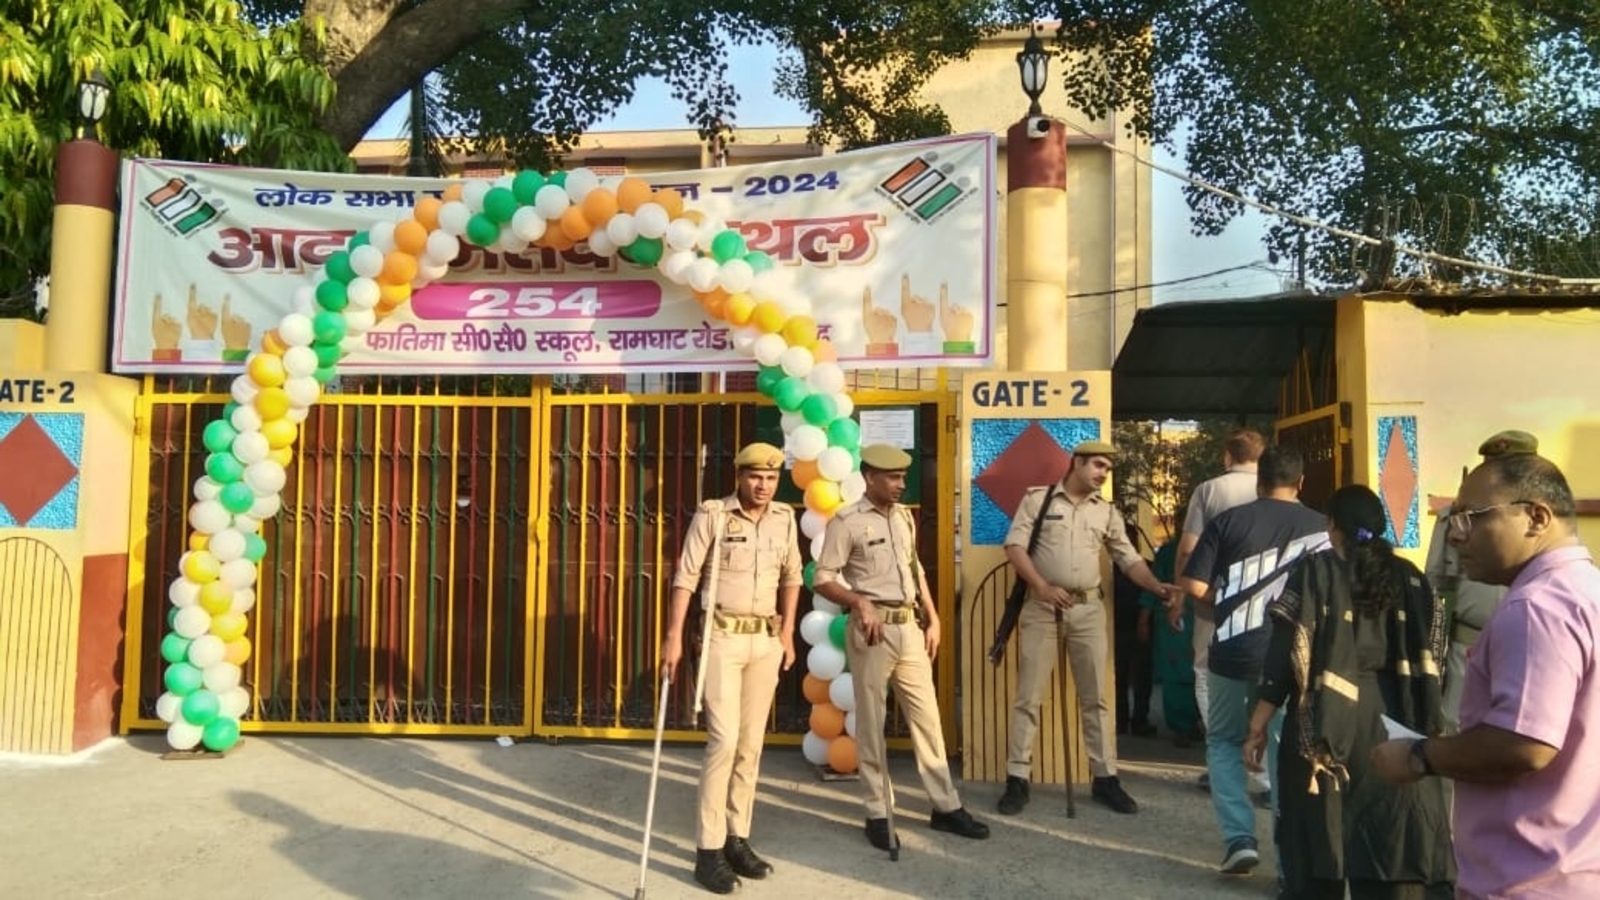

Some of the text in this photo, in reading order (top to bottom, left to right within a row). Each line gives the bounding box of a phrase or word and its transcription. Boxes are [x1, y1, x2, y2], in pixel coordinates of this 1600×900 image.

[254, 182, 336, 207] लोक
[343, 190, 416, 207] सभा
[744, 171, 840, 197] 2024
[207, 213, 882, 270] आद थल
[465, 286, 603, 318] 254
[366, 323, 447, 352] फातिमा
[608, 329, 689, 351] रामघाट
[0, 379, 75, 403] ATE-2
